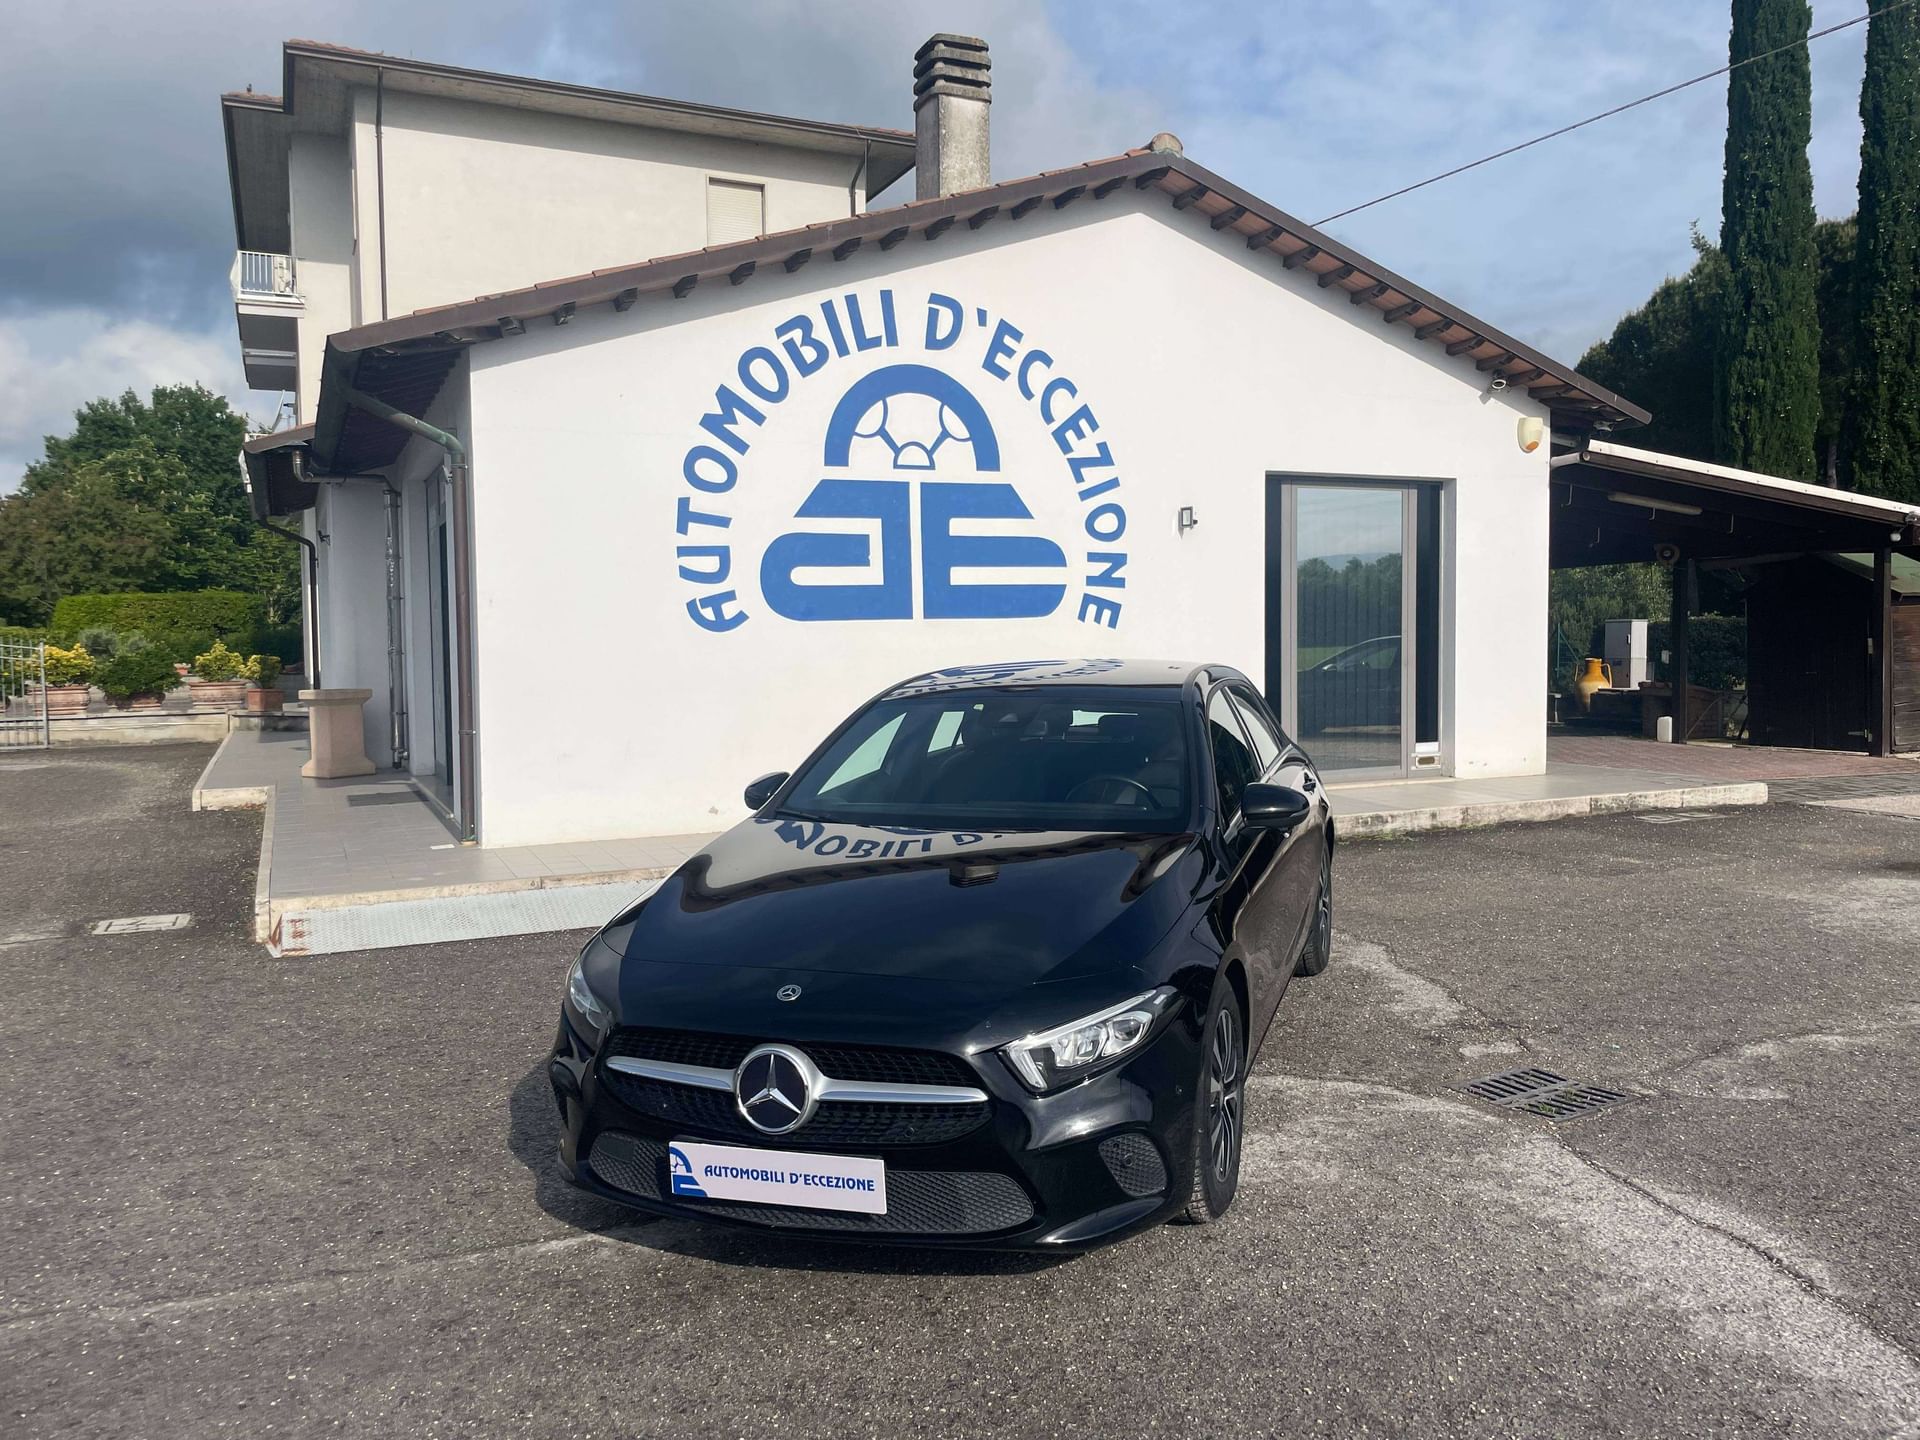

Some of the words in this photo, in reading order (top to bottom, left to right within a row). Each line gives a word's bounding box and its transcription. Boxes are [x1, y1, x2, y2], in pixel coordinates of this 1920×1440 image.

[675, 289, 900, 633] AUTOMOBILI
[924, 292, 1128, 631] D'ECCEZIONE
[703, 1164, 785, 1184] AUTOMOBILI
[789, 1172, 875, 1192] D'ECCEZIONE
